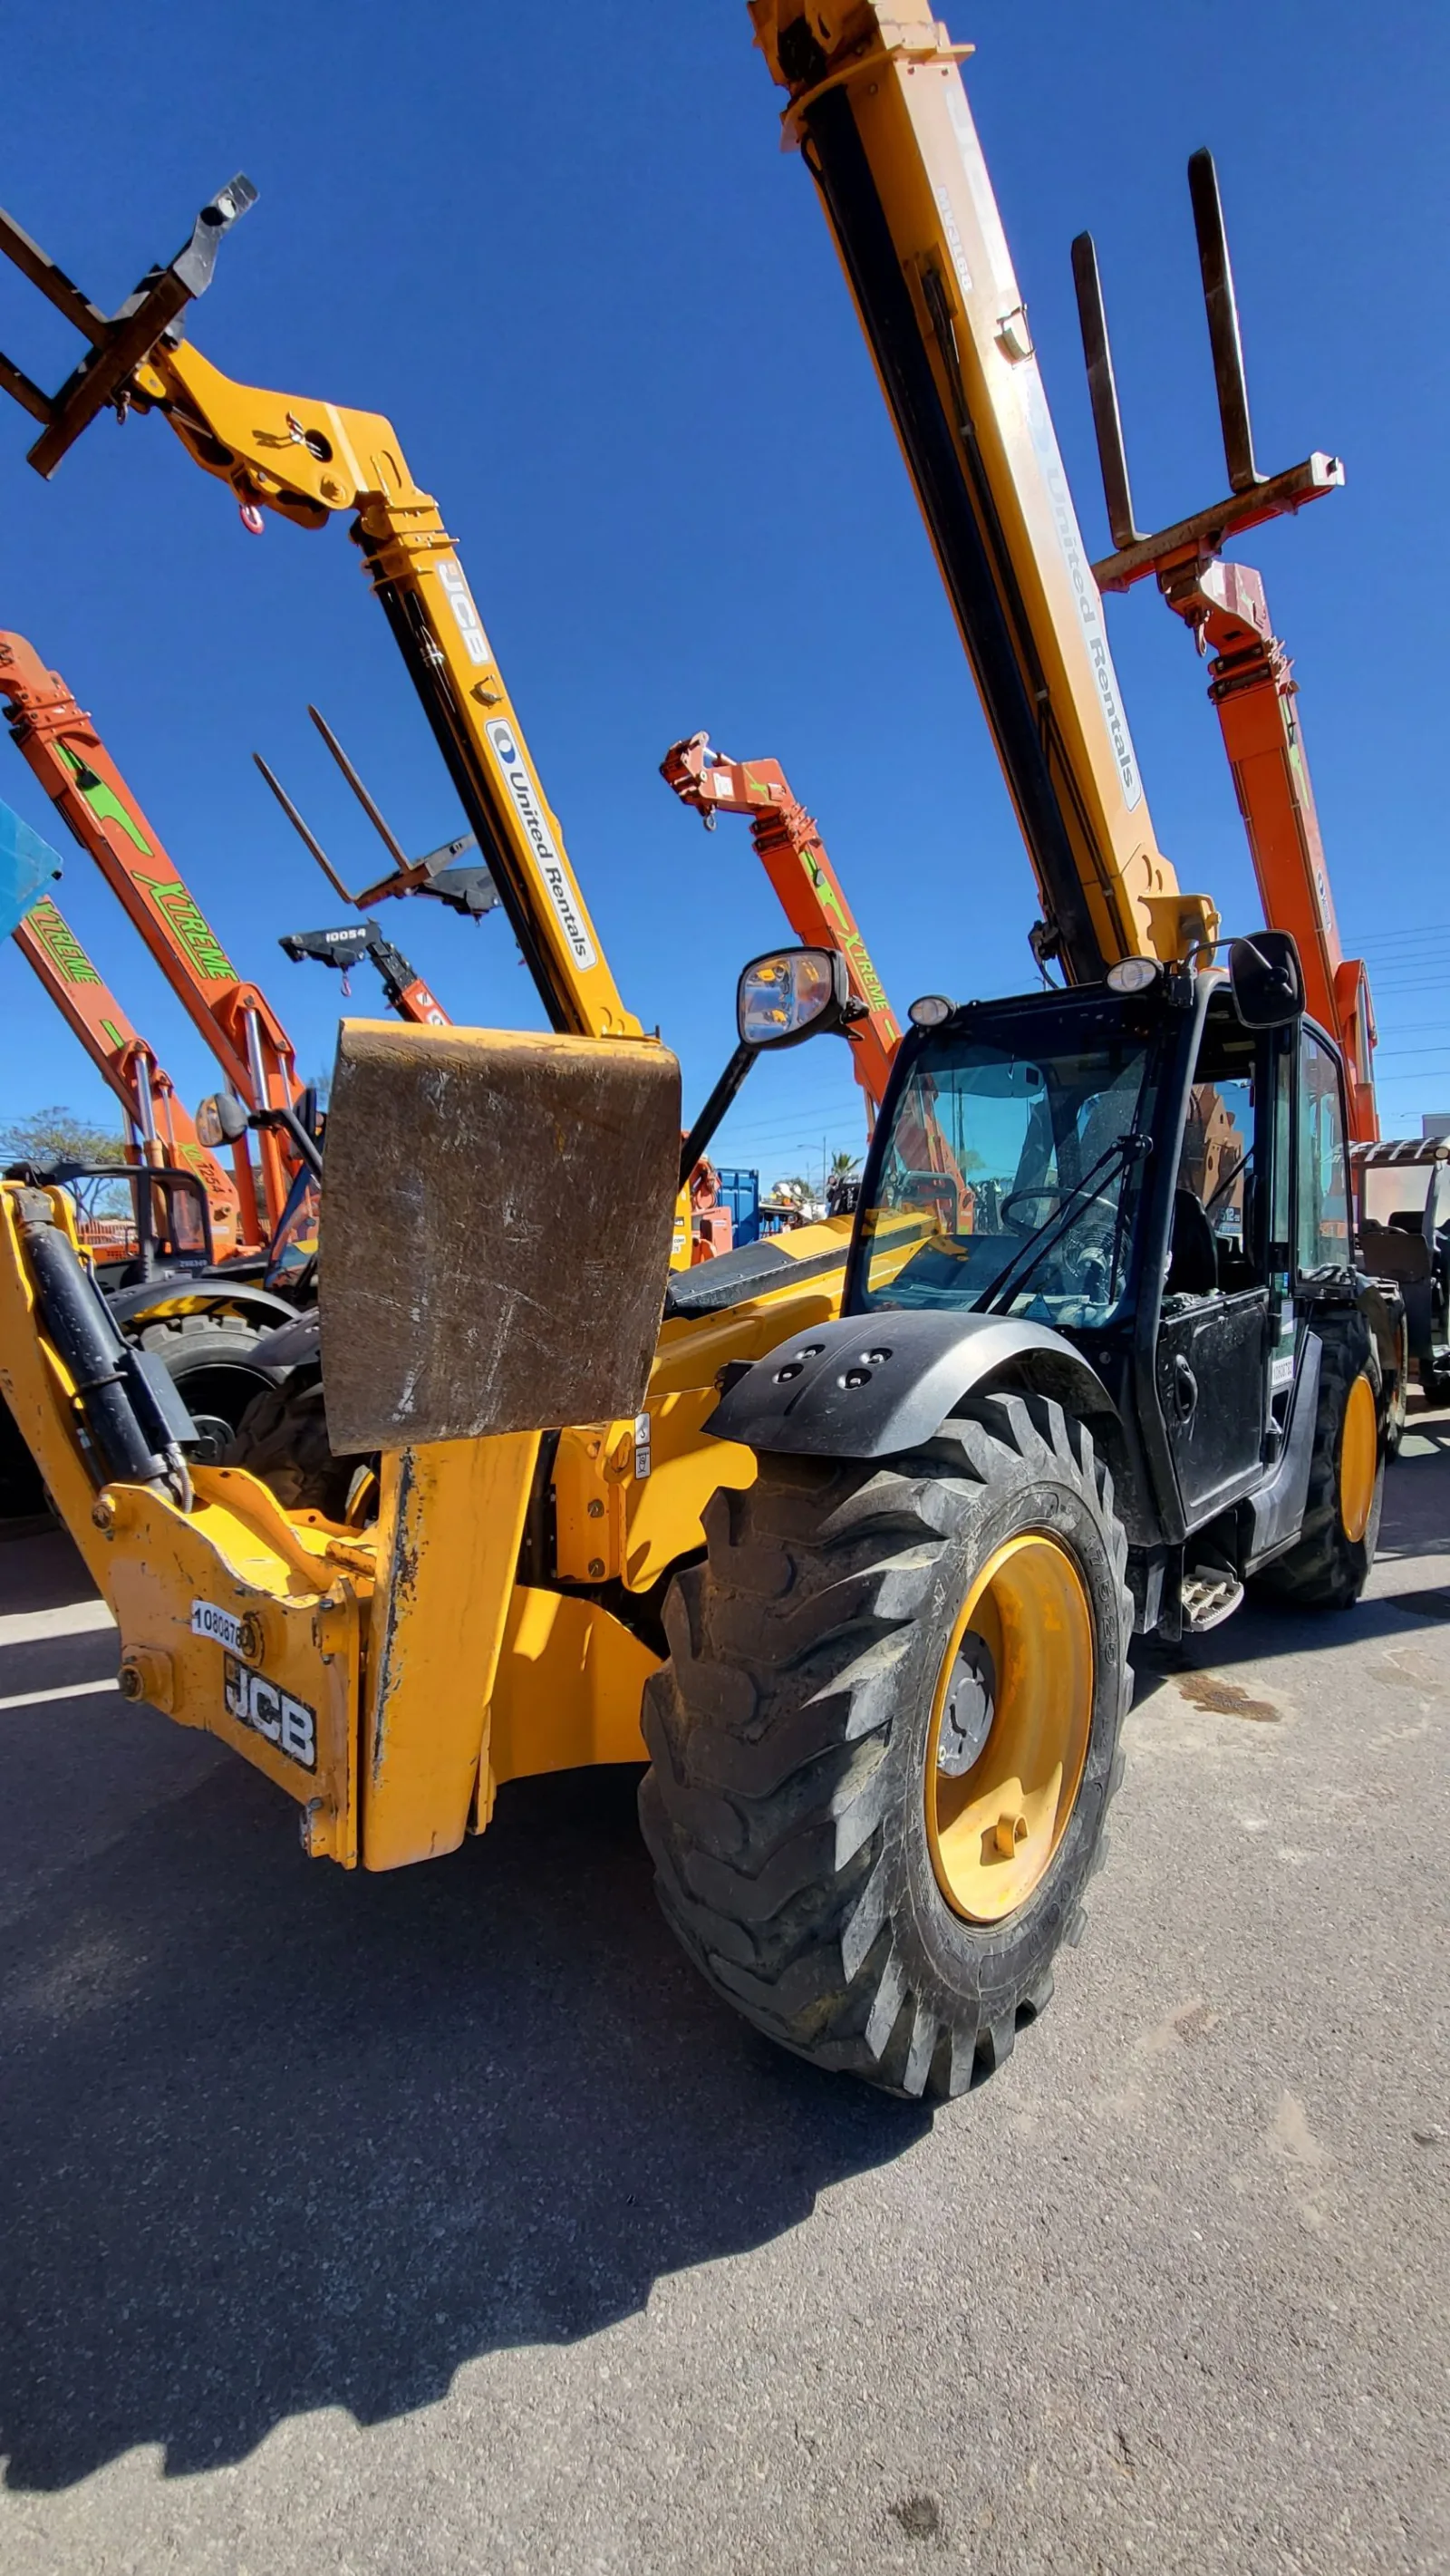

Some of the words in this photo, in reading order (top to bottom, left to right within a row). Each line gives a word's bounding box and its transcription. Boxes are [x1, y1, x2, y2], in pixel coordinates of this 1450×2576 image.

[438, 563, 490, 664] JCB
[1046, 467, 1095, 625] United
[1089, 638, 1133, 791] Rentals
[510, 771, 553, 859] United
[546, 867, 586, 957] Rentals
[130, 870, 239, 983] XTREME
[325, 927, 366, 943] 10054
[836, 931, 890, 1012] XTREME
[226, 1667, 315, 1767] JCB
